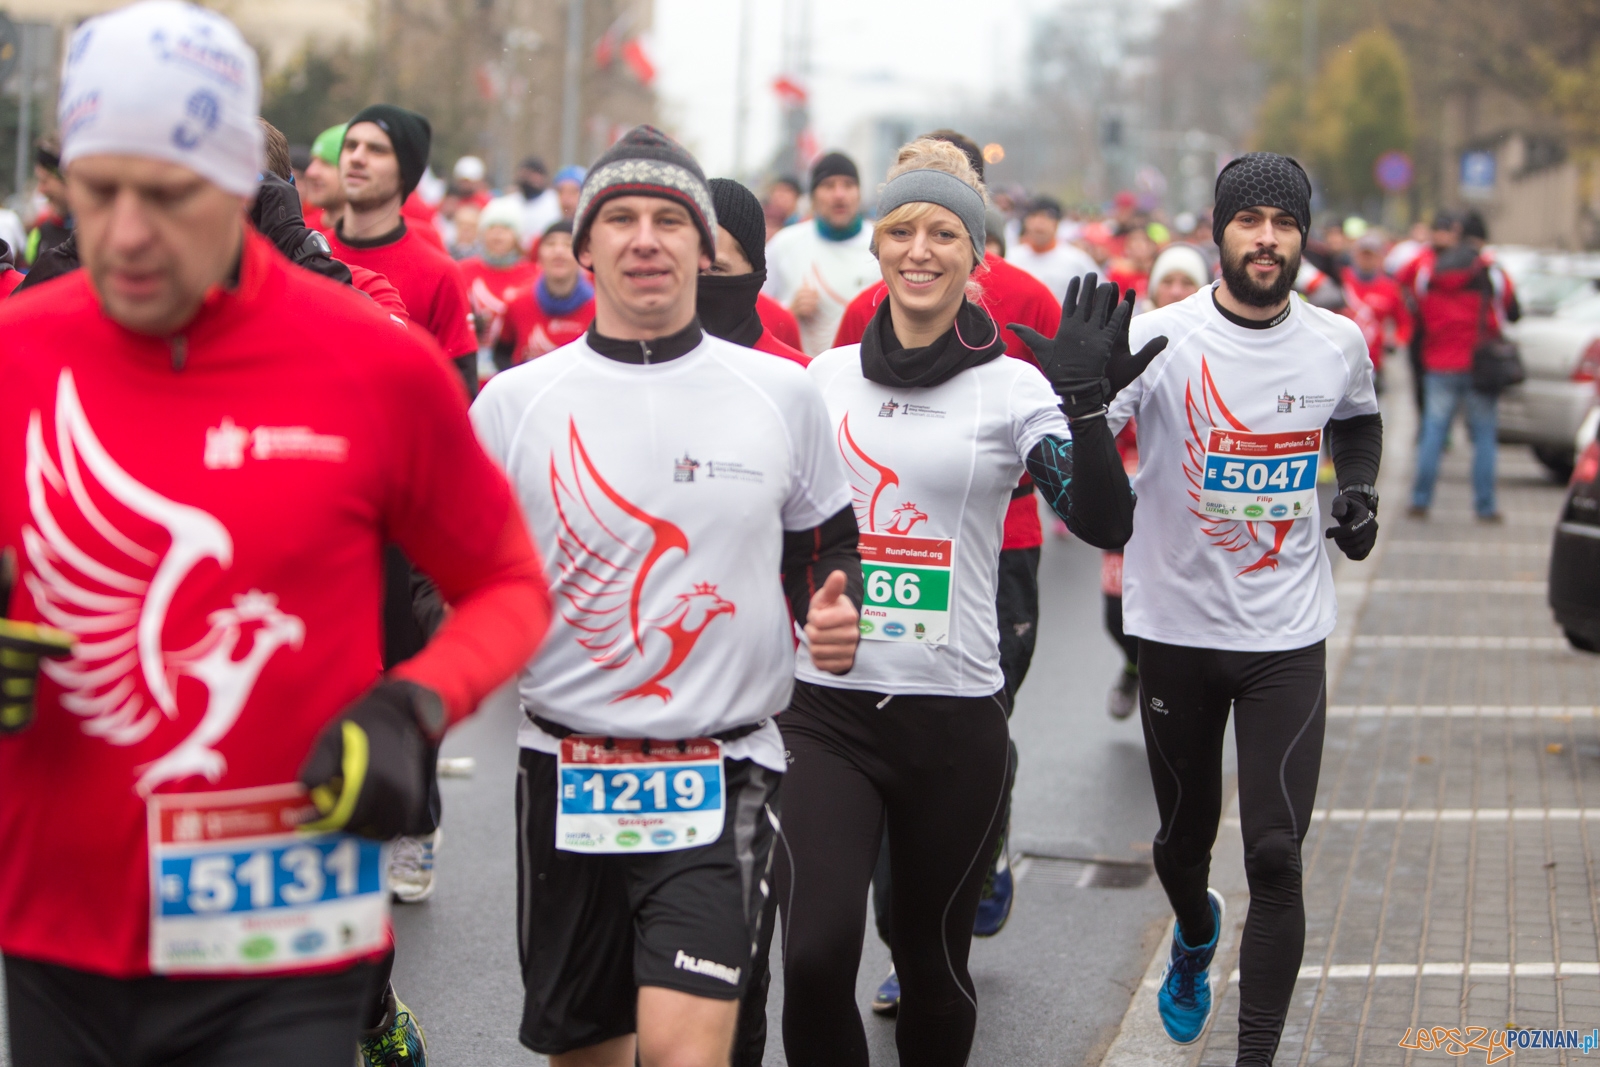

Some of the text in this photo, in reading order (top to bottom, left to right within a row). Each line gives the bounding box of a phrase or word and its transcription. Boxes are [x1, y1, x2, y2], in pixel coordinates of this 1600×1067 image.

[1299, 395, 1306, 408] 1
[901, 403, 909, 415] 1
[1274, 440, 1315, 449] RunPoland.org
[706, 460, 715, 477] 1
[1208, 459, 1308, 491] E 5047
[1205, 507, 1229, 515] LUXMED
[885, 547, 943, 560] RunPoland.org
[862, 570, 921, 606] 66
[864, 609, 887, 617] Anna
[564, 770, 705, 811] E 1219
[188, 838, 360, 913] 5131
